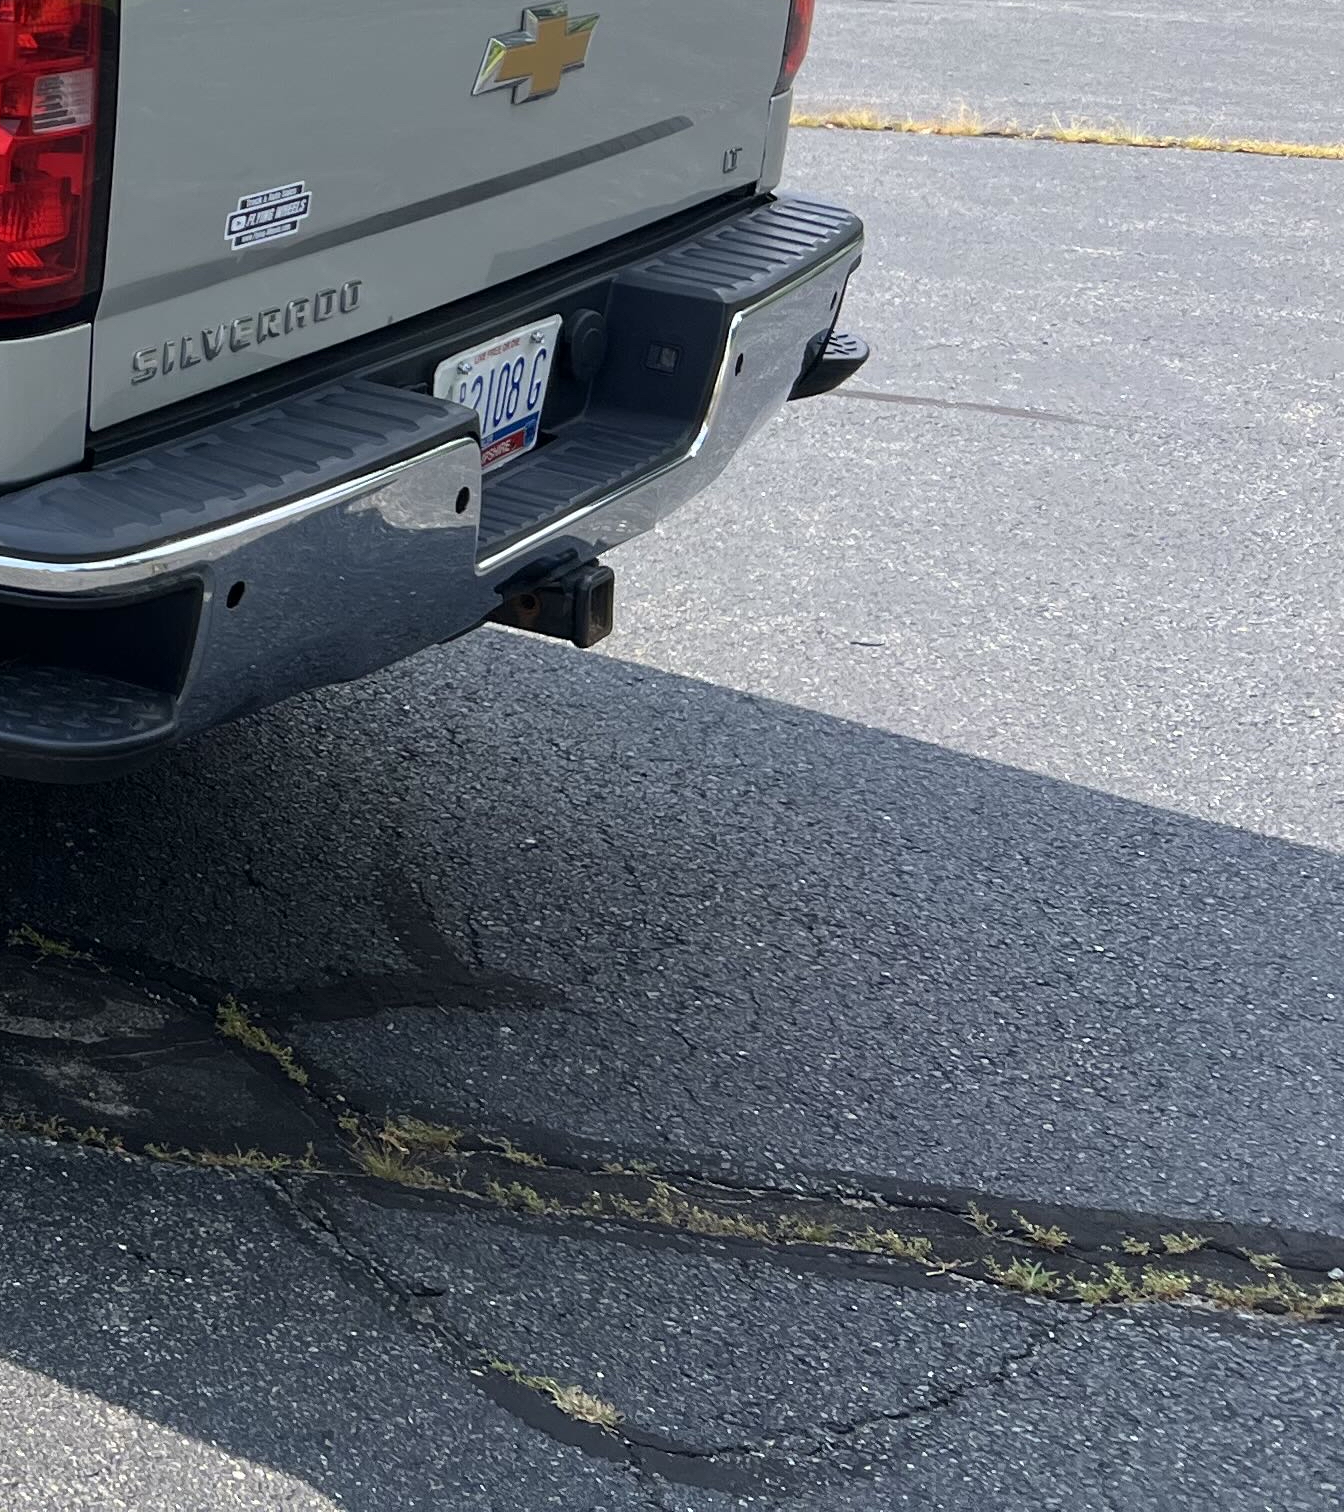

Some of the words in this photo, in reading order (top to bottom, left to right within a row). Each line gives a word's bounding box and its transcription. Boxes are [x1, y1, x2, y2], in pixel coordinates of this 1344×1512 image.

[246, 208, 275, 226] FLYING
[274, 198, 307, 219] WHEELS
[131, 279, 363, 385] SILVERADO
[526, 347, 547, 410] G
